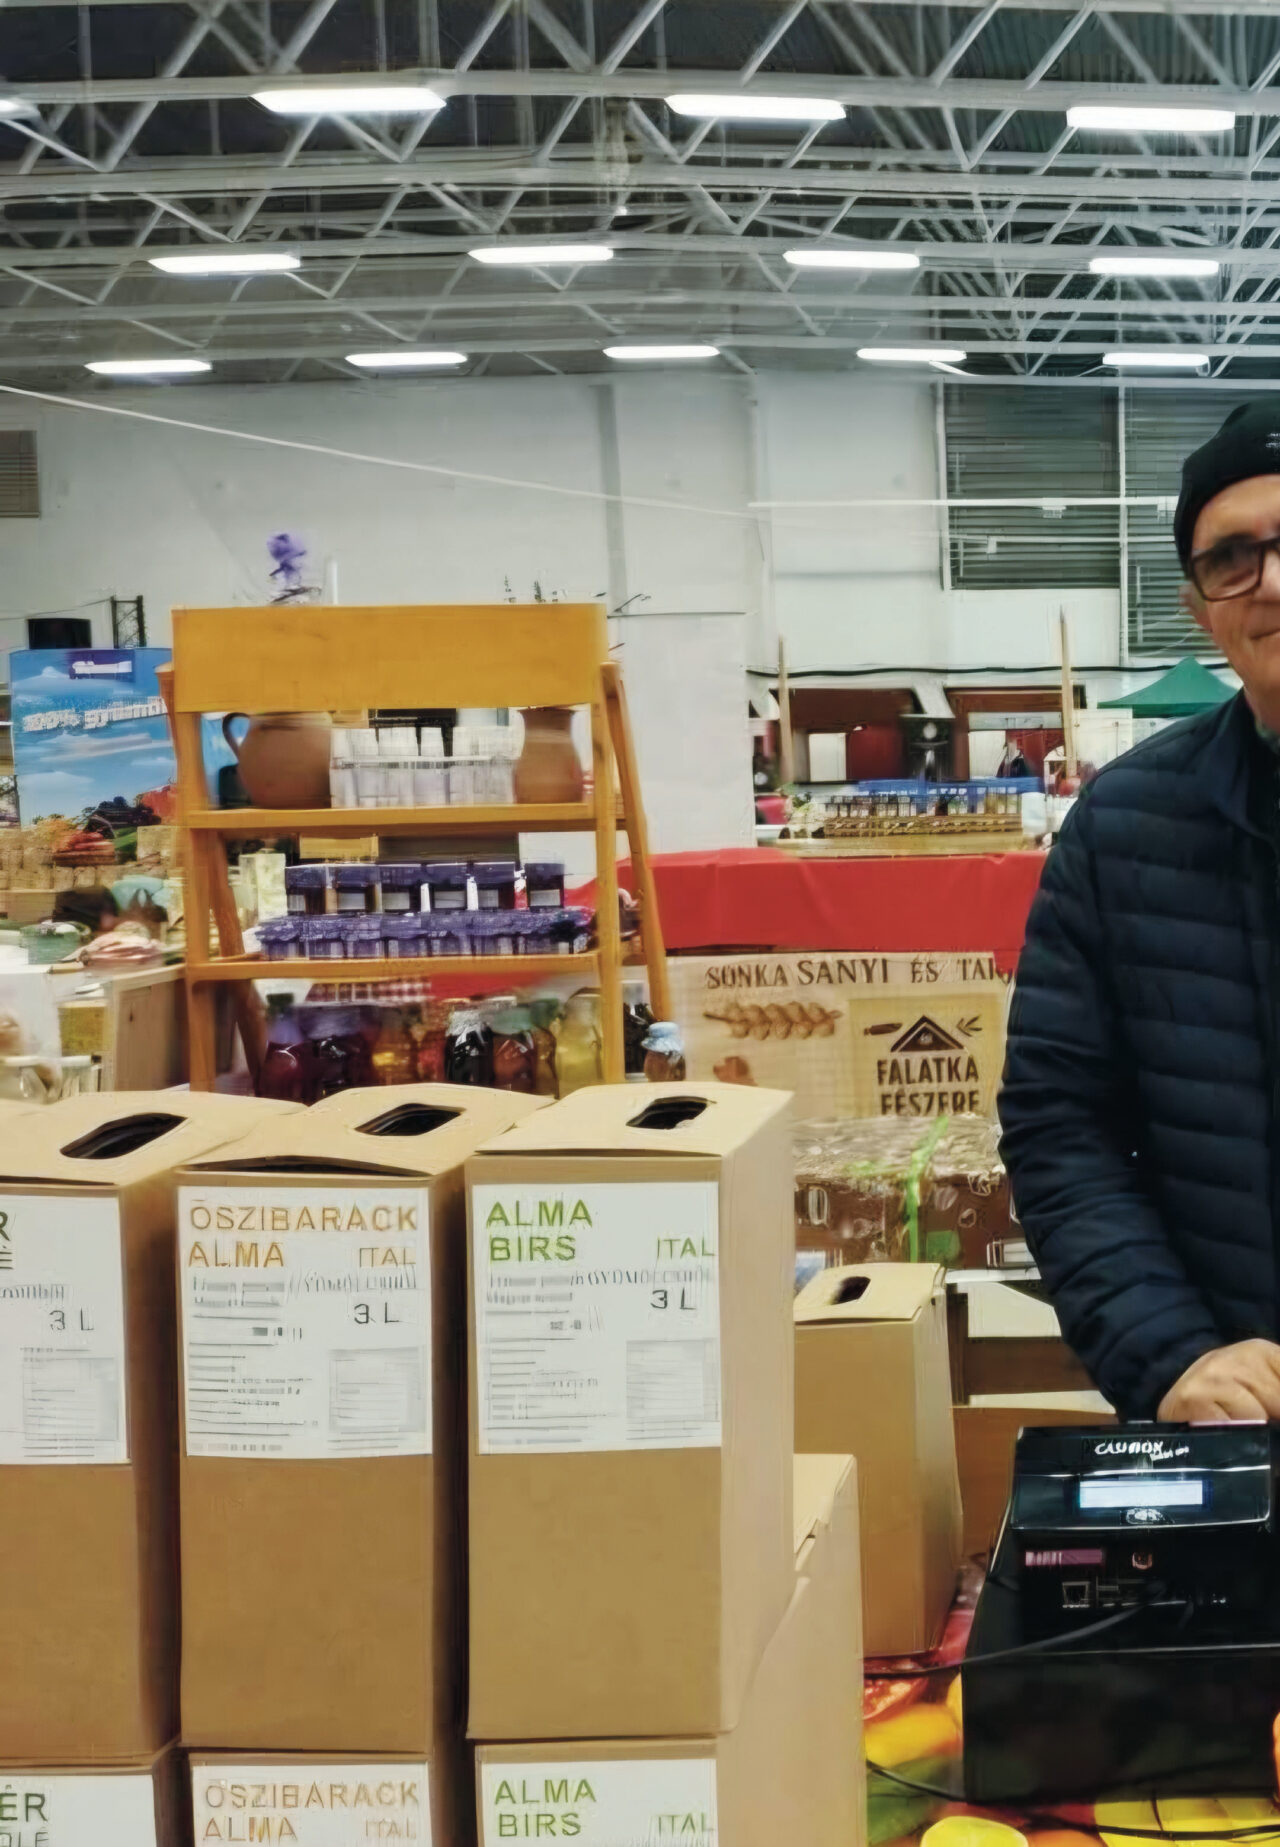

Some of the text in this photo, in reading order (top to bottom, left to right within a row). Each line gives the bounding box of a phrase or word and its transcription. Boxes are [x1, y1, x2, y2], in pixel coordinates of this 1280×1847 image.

[797, 957, 890, 985] SANYI
[876, 1055, 980, 1086] FALATKA
[486, 1200, 593, 1228] ALMA
[188, 1240, 417, 1268] ALMA ITAL
[490, 1235, 716, 1262] BIRS ITAL
[494, 1779, 597, 1805] ALMA
[203, 1817, 298, 1843] ALMA
[499, 1812, 714, 1838] BIRS ITAL
